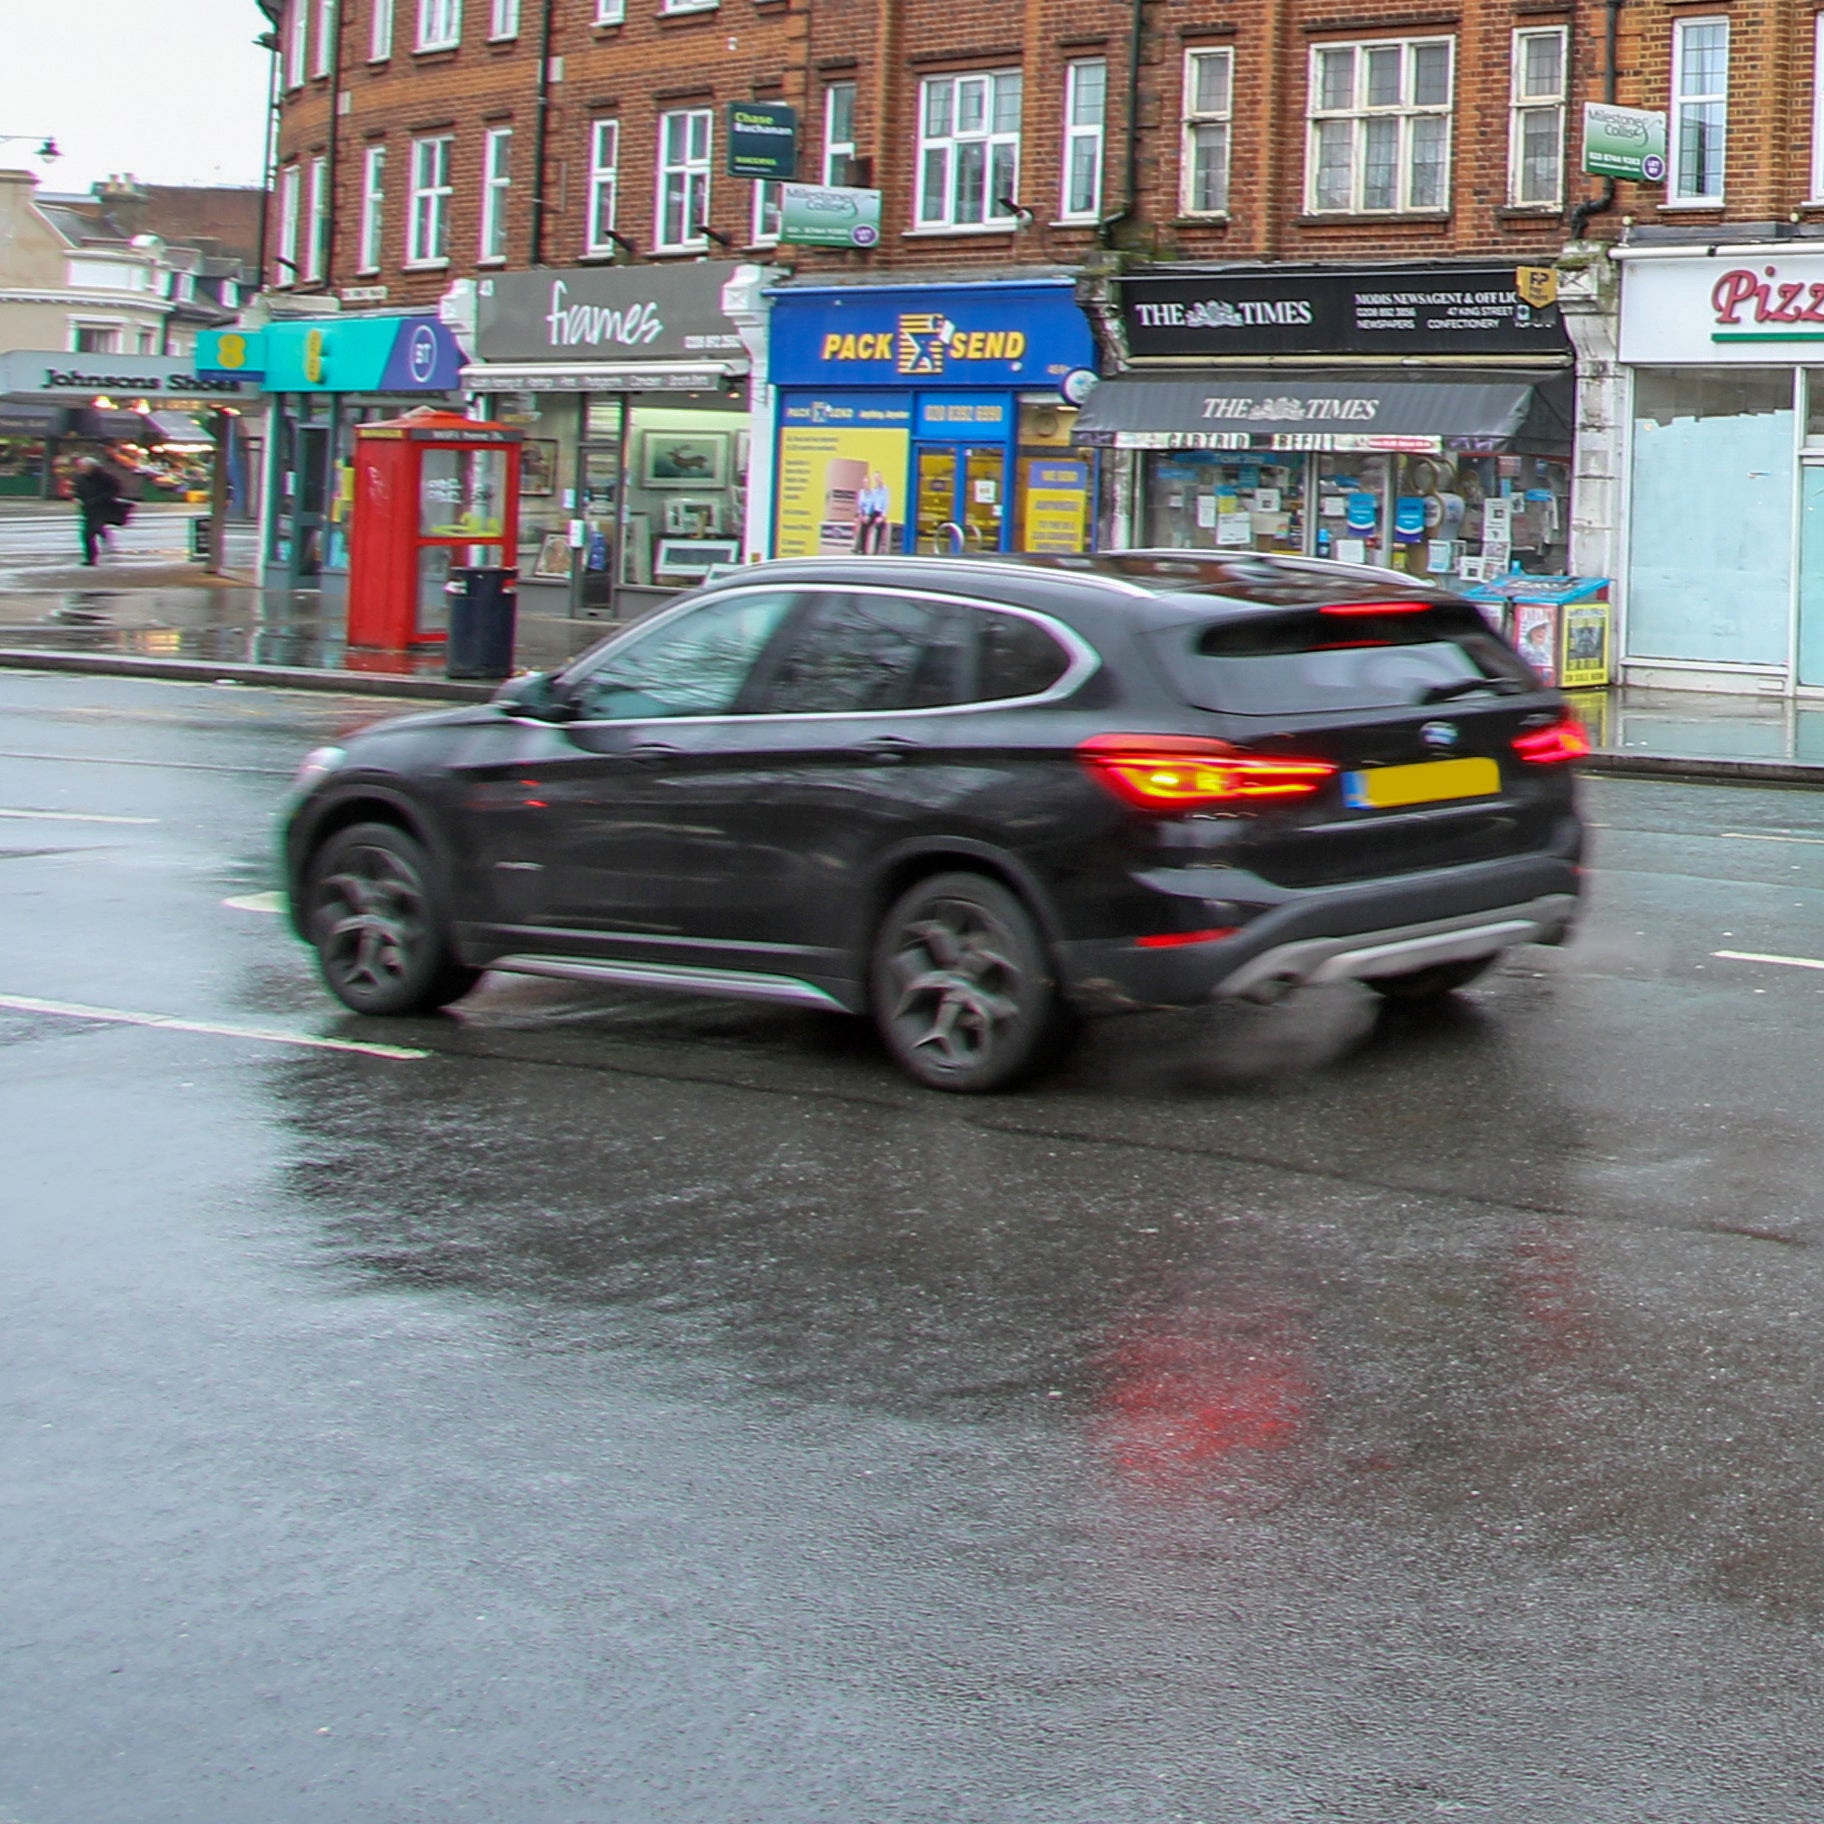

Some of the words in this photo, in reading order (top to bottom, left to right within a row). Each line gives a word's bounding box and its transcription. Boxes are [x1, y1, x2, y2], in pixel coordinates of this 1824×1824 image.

[734, 112, 774, 125] Chase
[1355, 293, 1393, 305] MODIS
[1393, 292, 1463, 305] NEWSAGENT
[1475, 292, 1498, 304] OFF
[545, 279, 664, 346] frames
[1136, 303, 1185, 326] THE
[1238, 301, 1313, 325] TIMES
[1459, 306, 1480, 317] KING
[1481, 305, 1514, 316] STREET
[1356, 319, 1416, 330] NEWSPAPERS
[1426, 318, 1500, 330] CONFECTIONERY
[822, 333, 894, 361] PACK
[949, 331, 1026, 360] SEND
[41, 368, 161, 390] Johnsons
[1201, 398, 1252, 419] THE
[1304, 399, 1379, 420] TIMES
